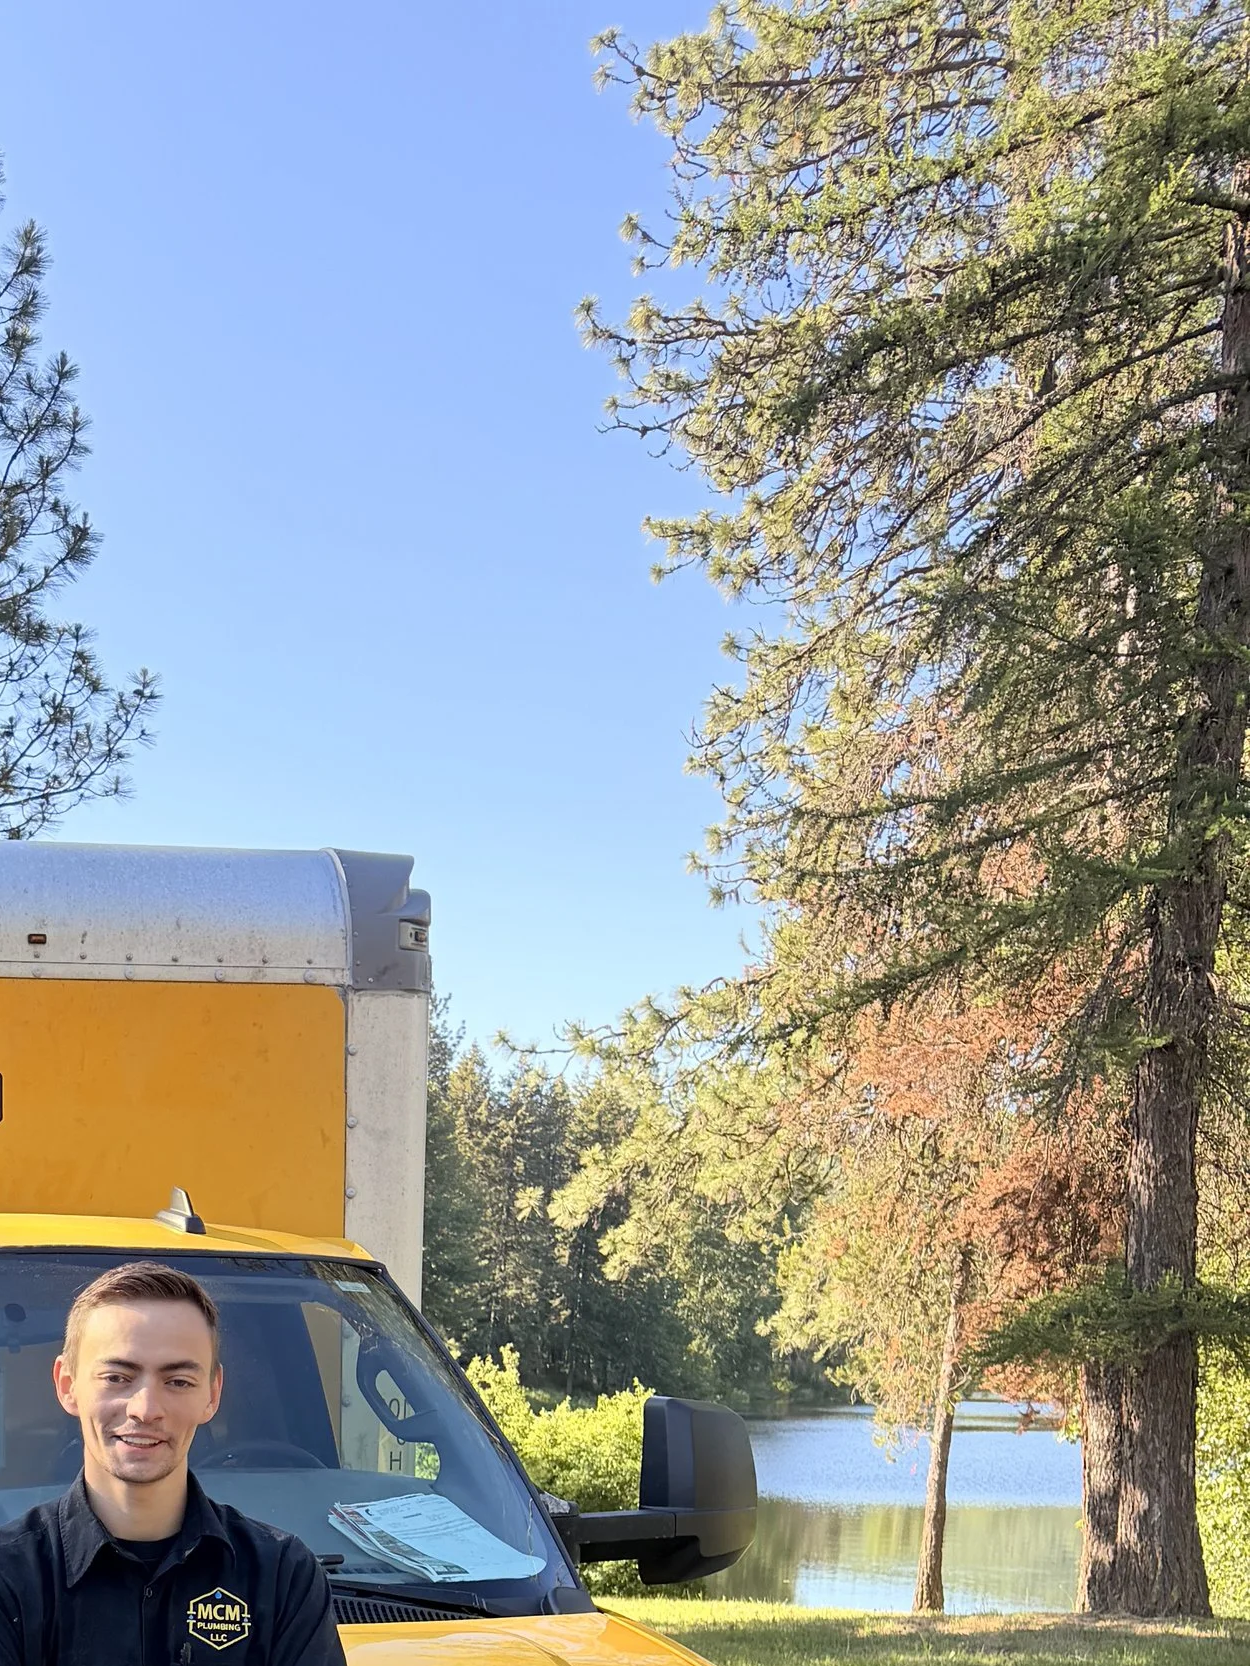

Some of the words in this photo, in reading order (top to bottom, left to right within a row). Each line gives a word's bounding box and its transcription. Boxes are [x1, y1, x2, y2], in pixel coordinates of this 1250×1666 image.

[197, 1603, 240, 1621] MCM
[197, 1622, 241, 1631] PLUMBING
[210, 1633, 227, 1642] LLC
